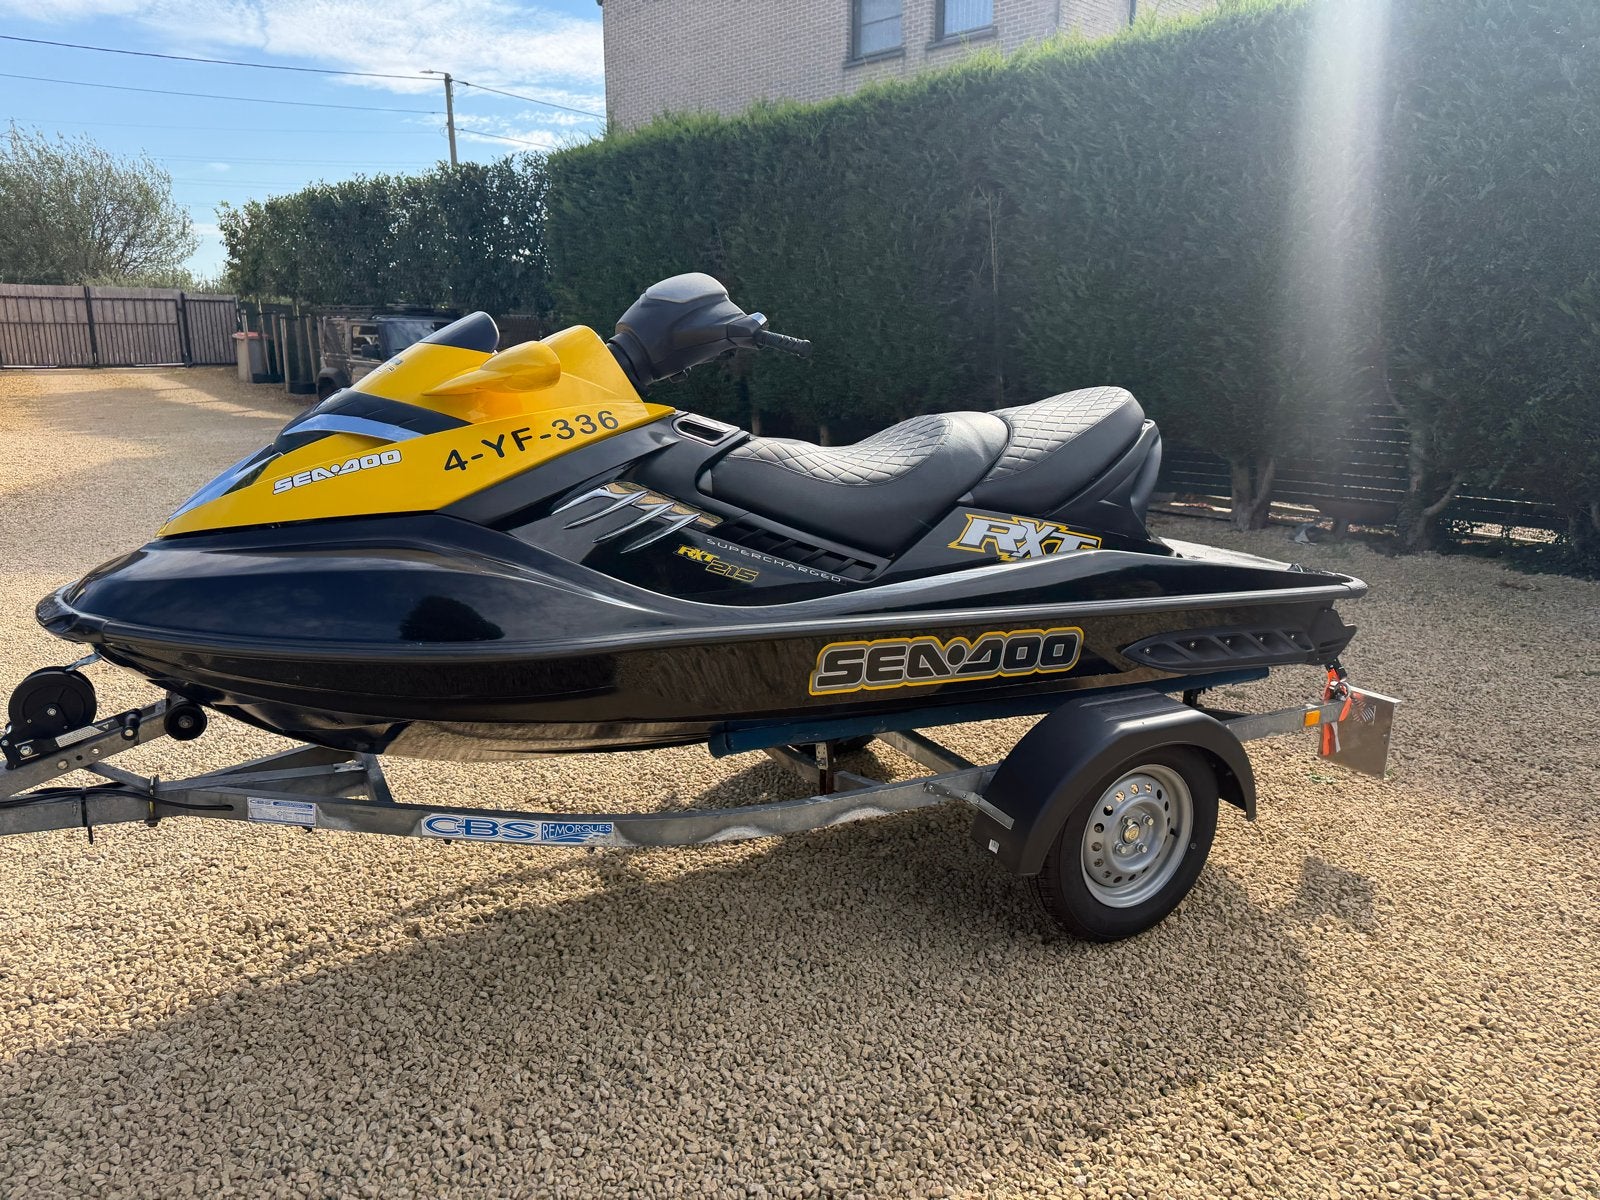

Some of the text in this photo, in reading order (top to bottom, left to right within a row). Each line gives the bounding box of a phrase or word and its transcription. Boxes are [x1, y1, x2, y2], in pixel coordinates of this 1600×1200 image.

[443, 410, 620, 473] 4-YF-336
[948, 514, 1102, 561] RXT
[676, 544, 760, 583] RXT 215
[706, 538, 842, 584] SUPERCHARGED
[423, 814, 613, 841] CBS REMORQUES
